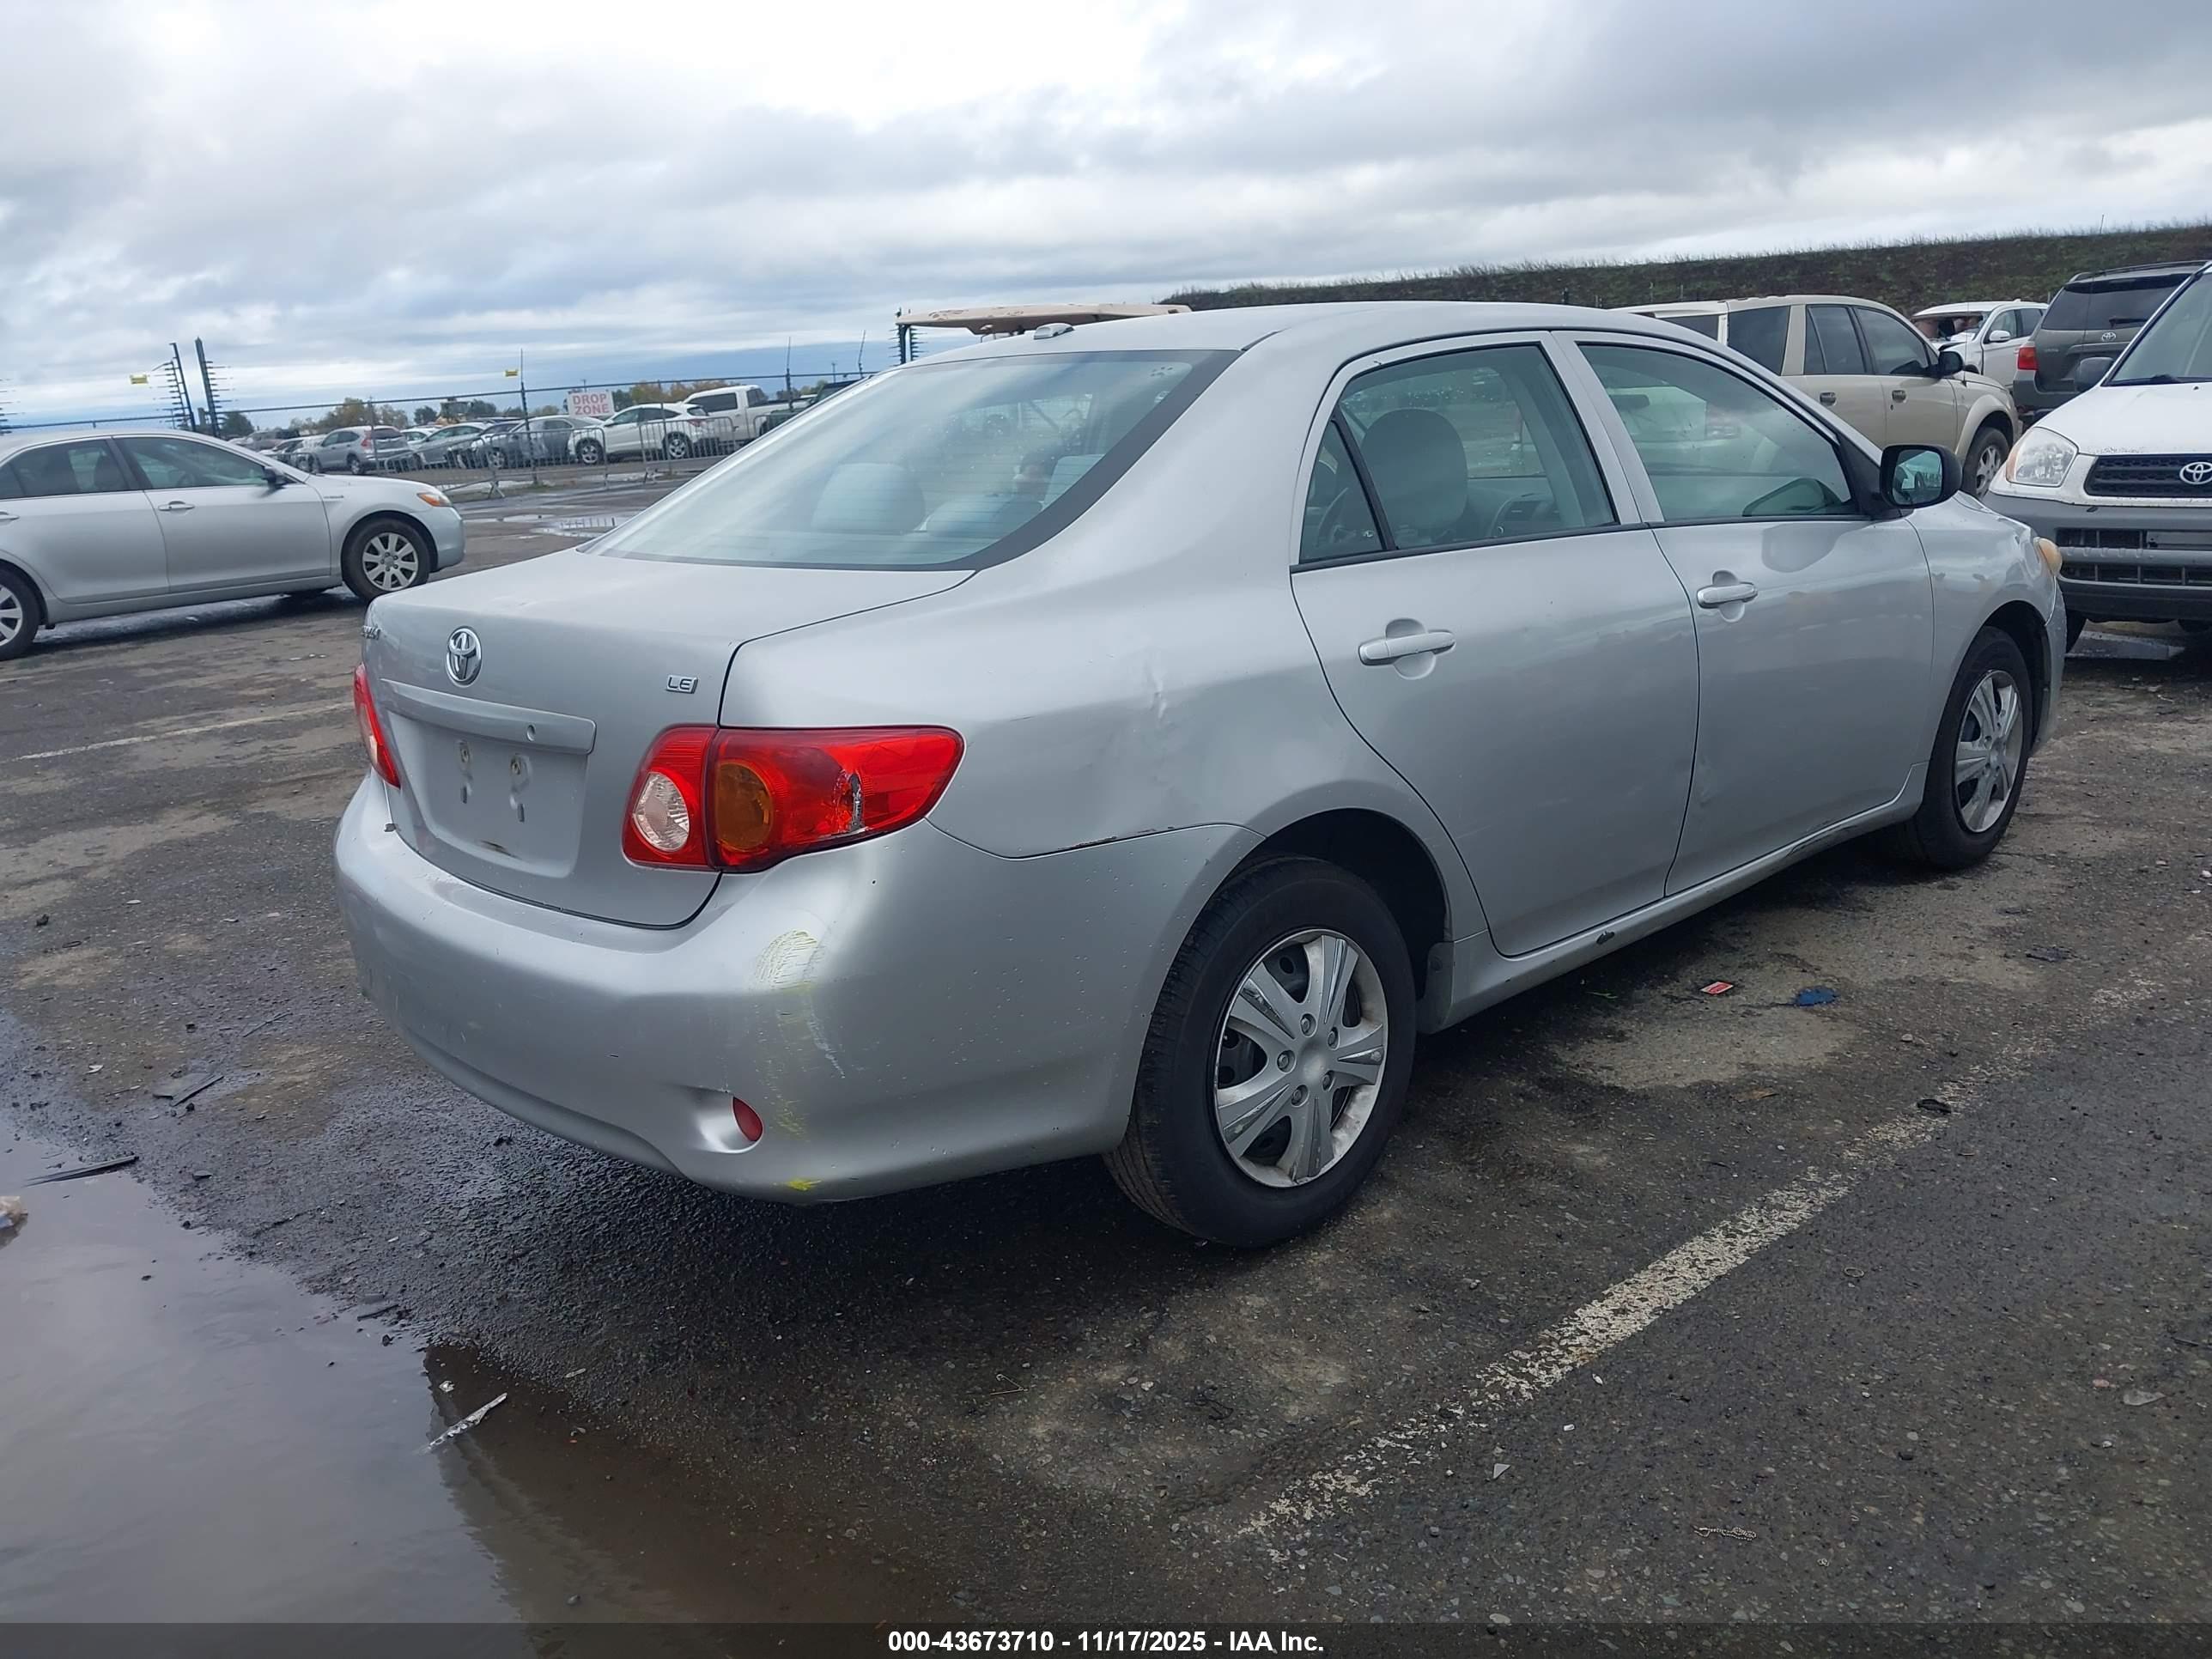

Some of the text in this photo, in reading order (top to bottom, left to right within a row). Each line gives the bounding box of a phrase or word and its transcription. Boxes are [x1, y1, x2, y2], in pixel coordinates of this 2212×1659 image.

[573, 393, 607, 404] DROP
[574, 404, 610, 415] ZONE
[667, 675, 694, 691] LE
